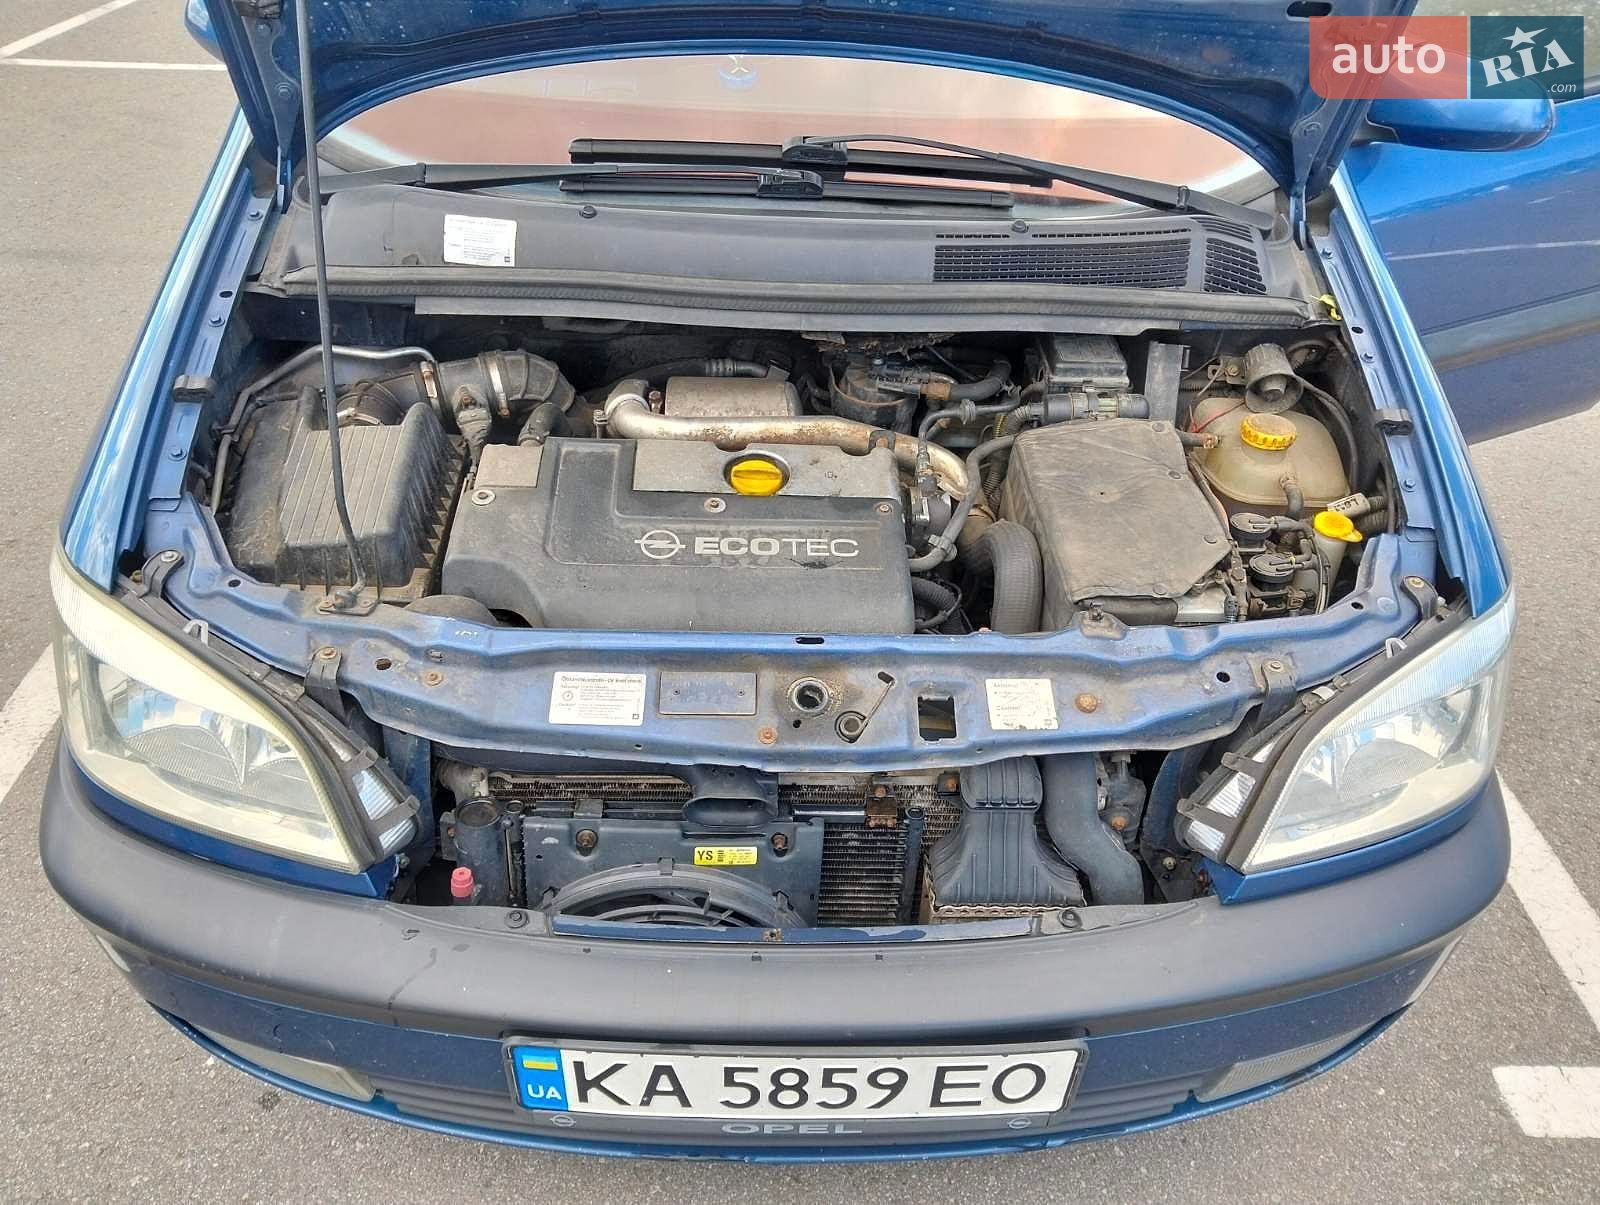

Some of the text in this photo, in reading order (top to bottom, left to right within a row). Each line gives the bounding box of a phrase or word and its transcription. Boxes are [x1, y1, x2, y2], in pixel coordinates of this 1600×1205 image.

[694, 536, 860, 558] ECOTEC
[697, 850, 714, 861] YS
[526, 1083, 563, 1101] UA
[572, 1060, 1047, 1110] KA 5859 EO
[720, 1121, 864, 1136] OPEL
